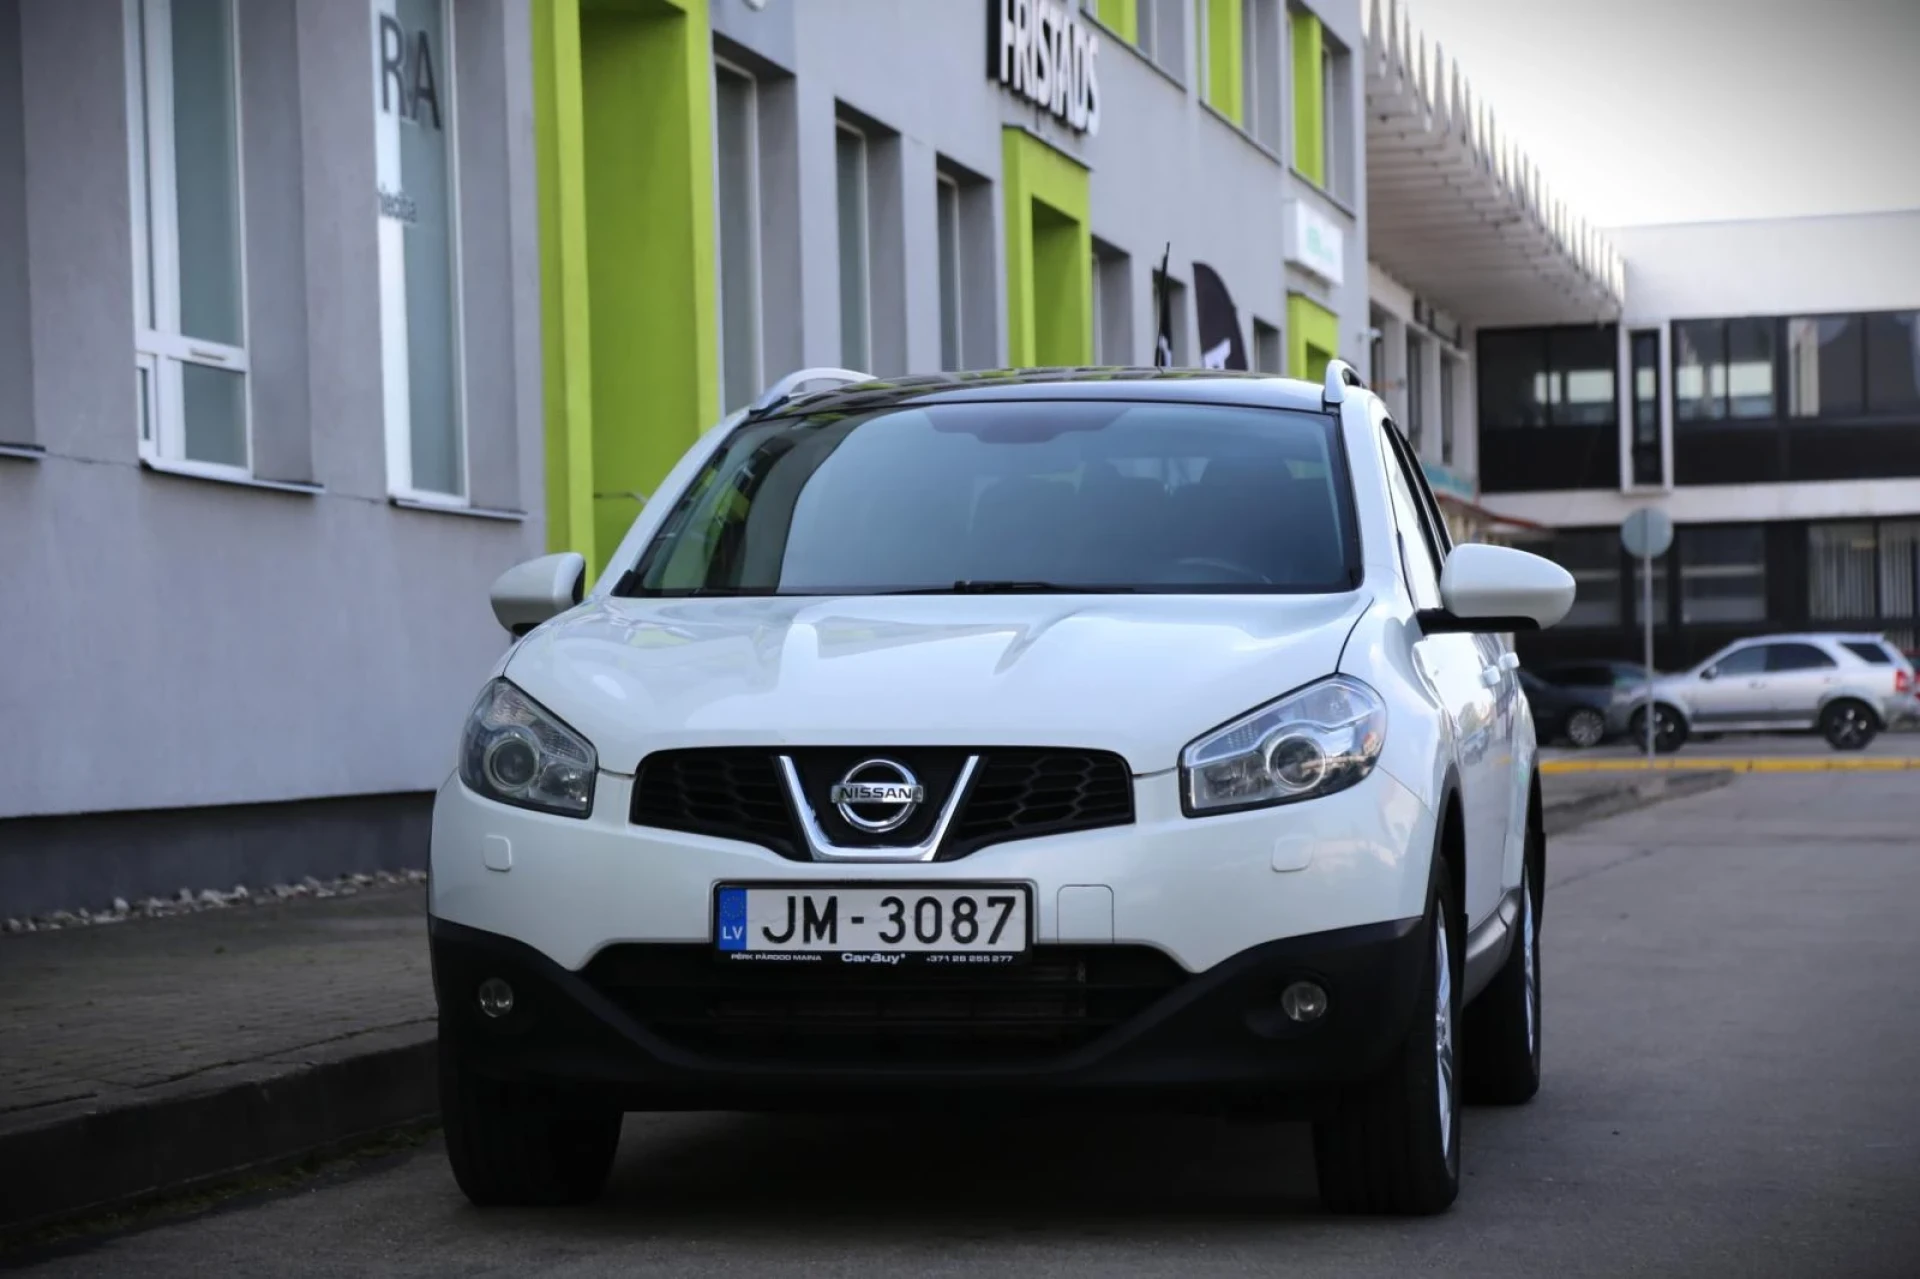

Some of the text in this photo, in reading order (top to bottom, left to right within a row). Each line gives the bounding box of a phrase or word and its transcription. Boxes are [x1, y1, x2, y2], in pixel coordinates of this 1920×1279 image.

[1000, 0, 1101, 137] FRISTADS
[840, 787, 913, 799] NISSAN
[722, 926, 743, 940] LV
